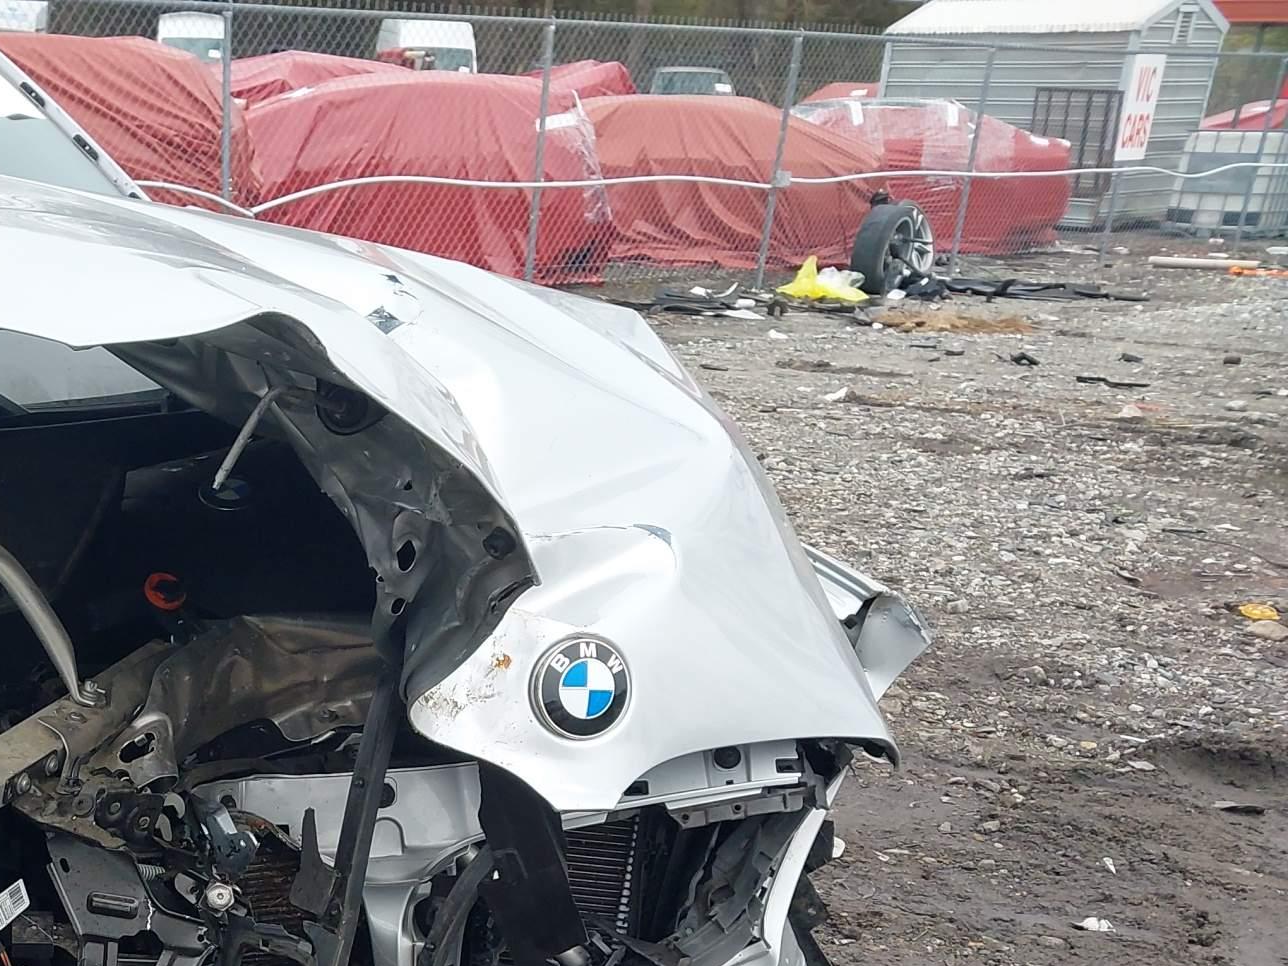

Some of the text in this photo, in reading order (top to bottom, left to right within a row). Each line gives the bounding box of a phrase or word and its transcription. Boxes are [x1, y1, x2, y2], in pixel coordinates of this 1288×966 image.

[1136, 65, 1158, 102] VIC
[1120, 112, 1151, 149] CARS
[550, 642, 623, 674] BMW
